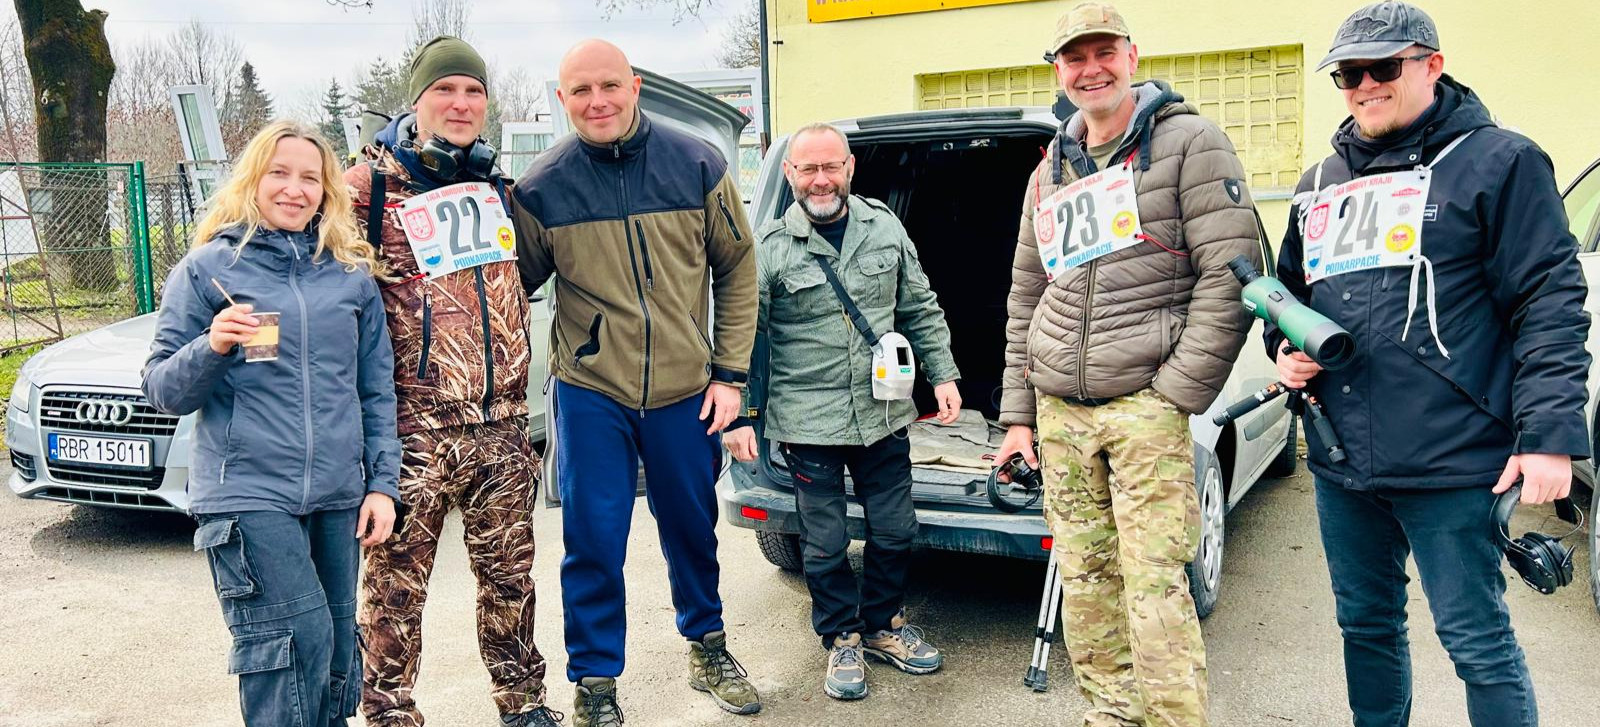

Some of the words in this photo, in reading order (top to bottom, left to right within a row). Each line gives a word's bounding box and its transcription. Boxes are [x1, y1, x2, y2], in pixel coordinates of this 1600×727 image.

[1370, 176, 1392, 187] KRAJU
[435, 196, 492, 256] 22
[1057, 191, 1100, 257] 23
[1333, 190, 1378, 257] 24
[453, 250, 503, 269] PODKARPACIE
[1064, 241, 1113, 270] PODKARPACIE
[1325, 254, 1381, 275] PODKARPACIE
[58, 438, 89, 460] RBR
[96, 441, 145, 464] 15011
